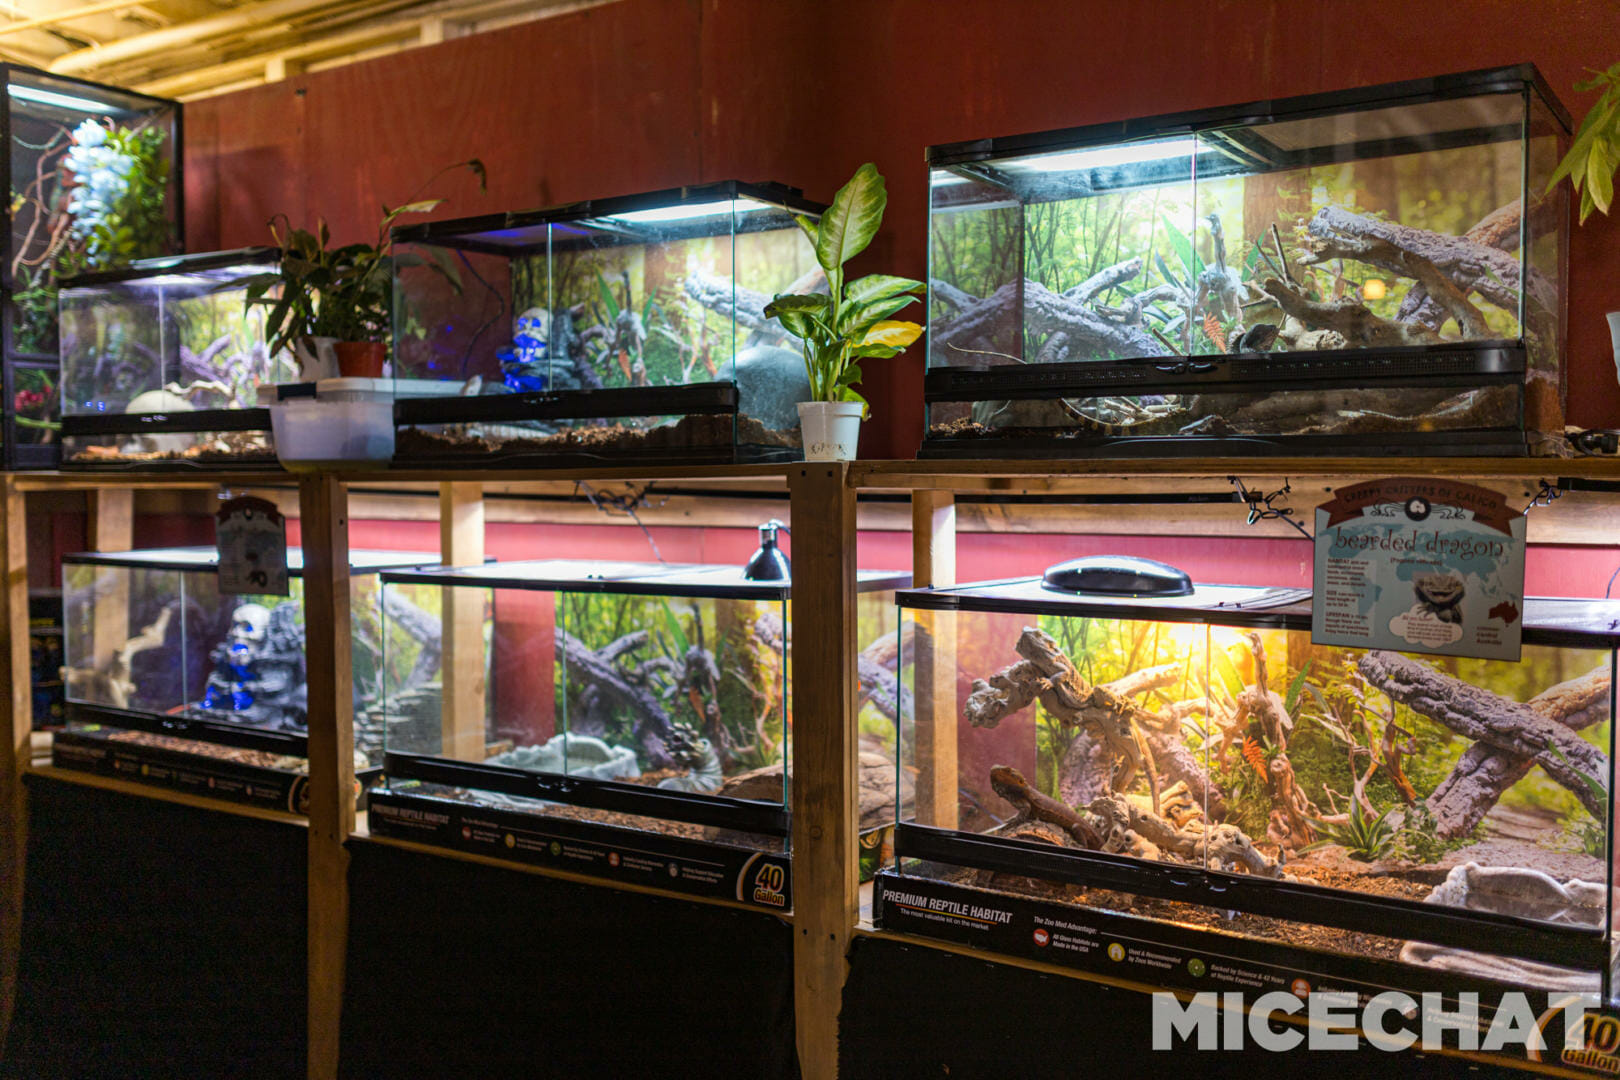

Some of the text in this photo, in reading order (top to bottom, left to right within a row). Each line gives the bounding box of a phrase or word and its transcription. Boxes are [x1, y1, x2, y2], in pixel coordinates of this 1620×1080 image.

[1385, 485, 1435, 496] CRITTERS
[1456, 490, 1497, 508] CALICO
[1335, 527, 1504, 561] bearded dragon
[756, 863, 784, 891] 40
[754, 888, 784, 906] Gallon
[882, 889, 1013, 924] PREMIUM REPTILE HABITAT
[910, 910, 924, 918] most
[924, 912, 946, 922] valuable
[971, 922, 989, 930] market
[1034, 916, 1098, 935] The Zoo Med Advantage:
[1052, 941, 1065, 949] Made
[1059, 934, 1072, 942] Glass
[1147, 959, 1172, 969] Worldwide
[1210, 964, 1229, 972] Backed
[1237, 969, 1257, 979] Science
[1217, 973, 1235, 983] Reptile
[1235, 976, 1263, 988] Experience
[1566, 1012, 1620, 1054] 40
[1561, 1047, 1620, 1074] Gallon
